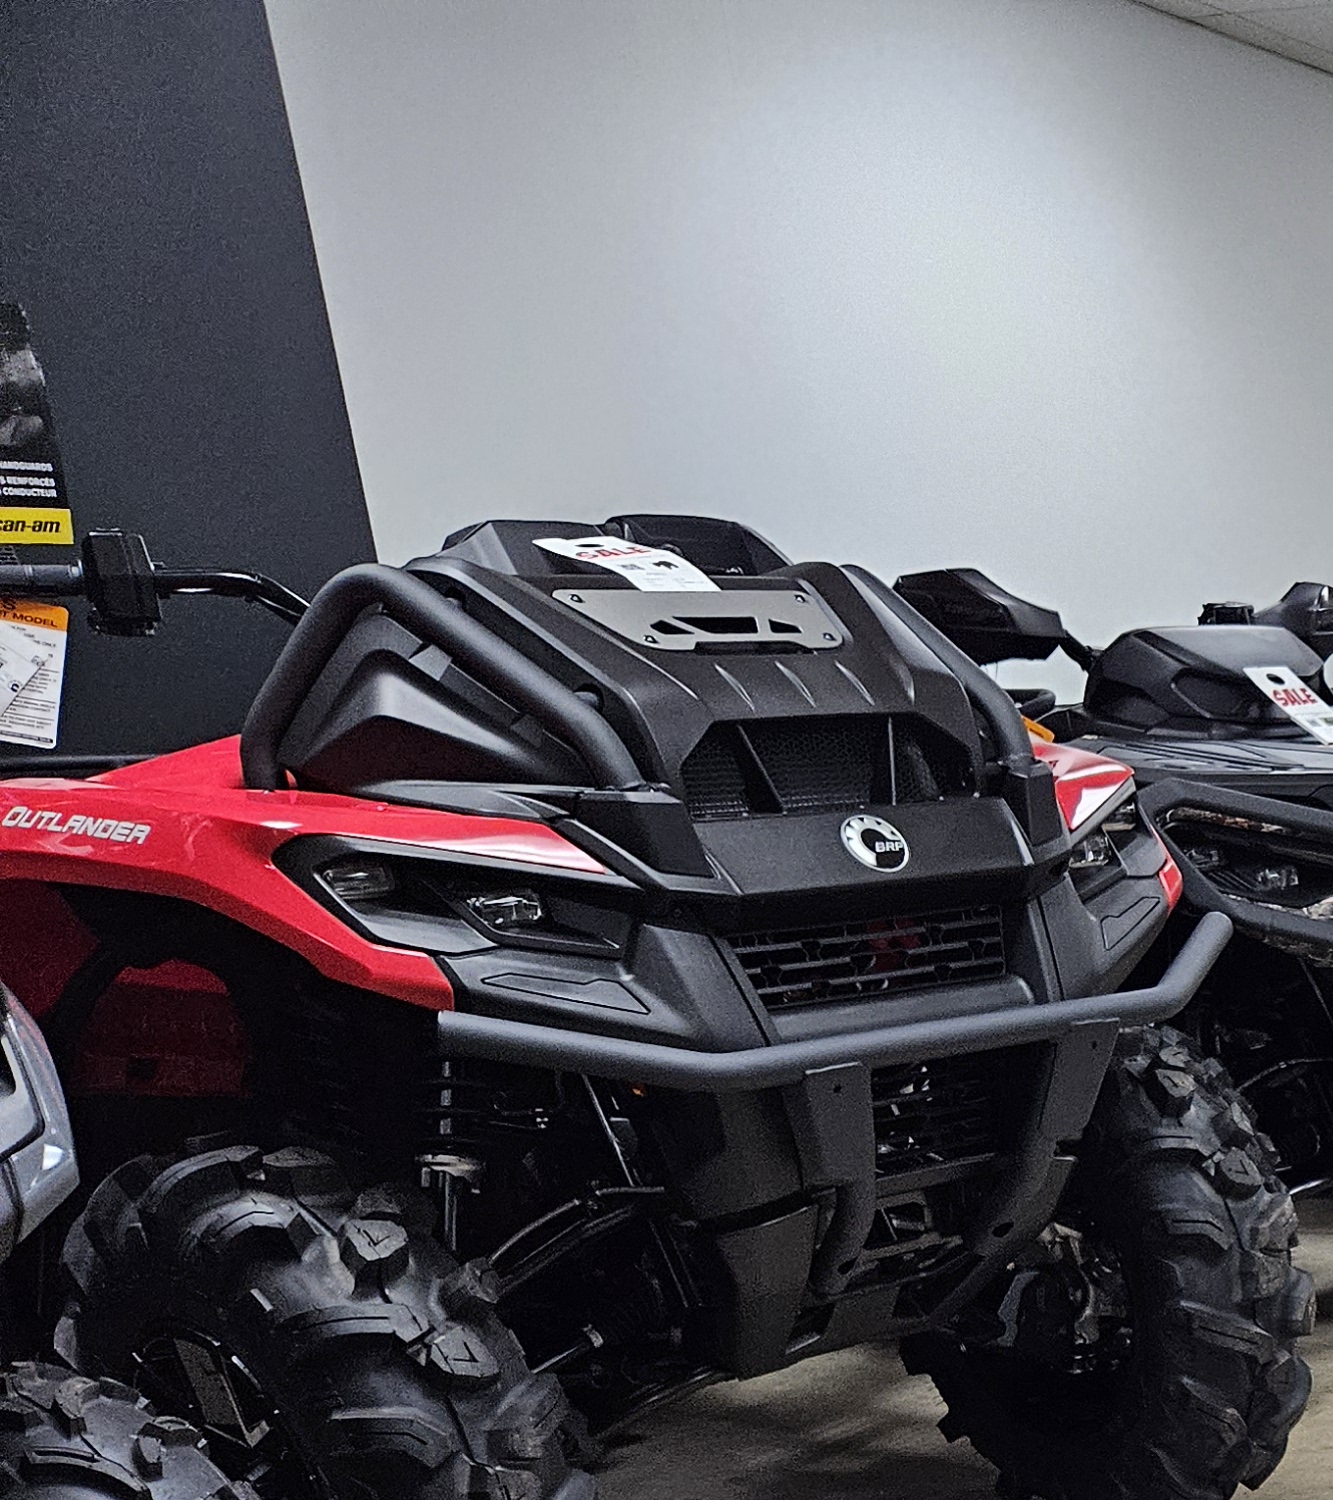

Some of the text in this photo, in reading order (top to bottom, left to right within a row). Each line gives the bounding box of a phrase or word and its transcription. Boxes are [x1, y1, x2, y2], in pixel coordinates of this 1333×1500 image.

[575, 546, 650, 560] SALE
[12, 612, 57, 628] MODEL
[1273, 687, 1318, 706] SALE
[1, 806, 151, 845] OUTLANDER
[875, 841, 904, 853] BRP
